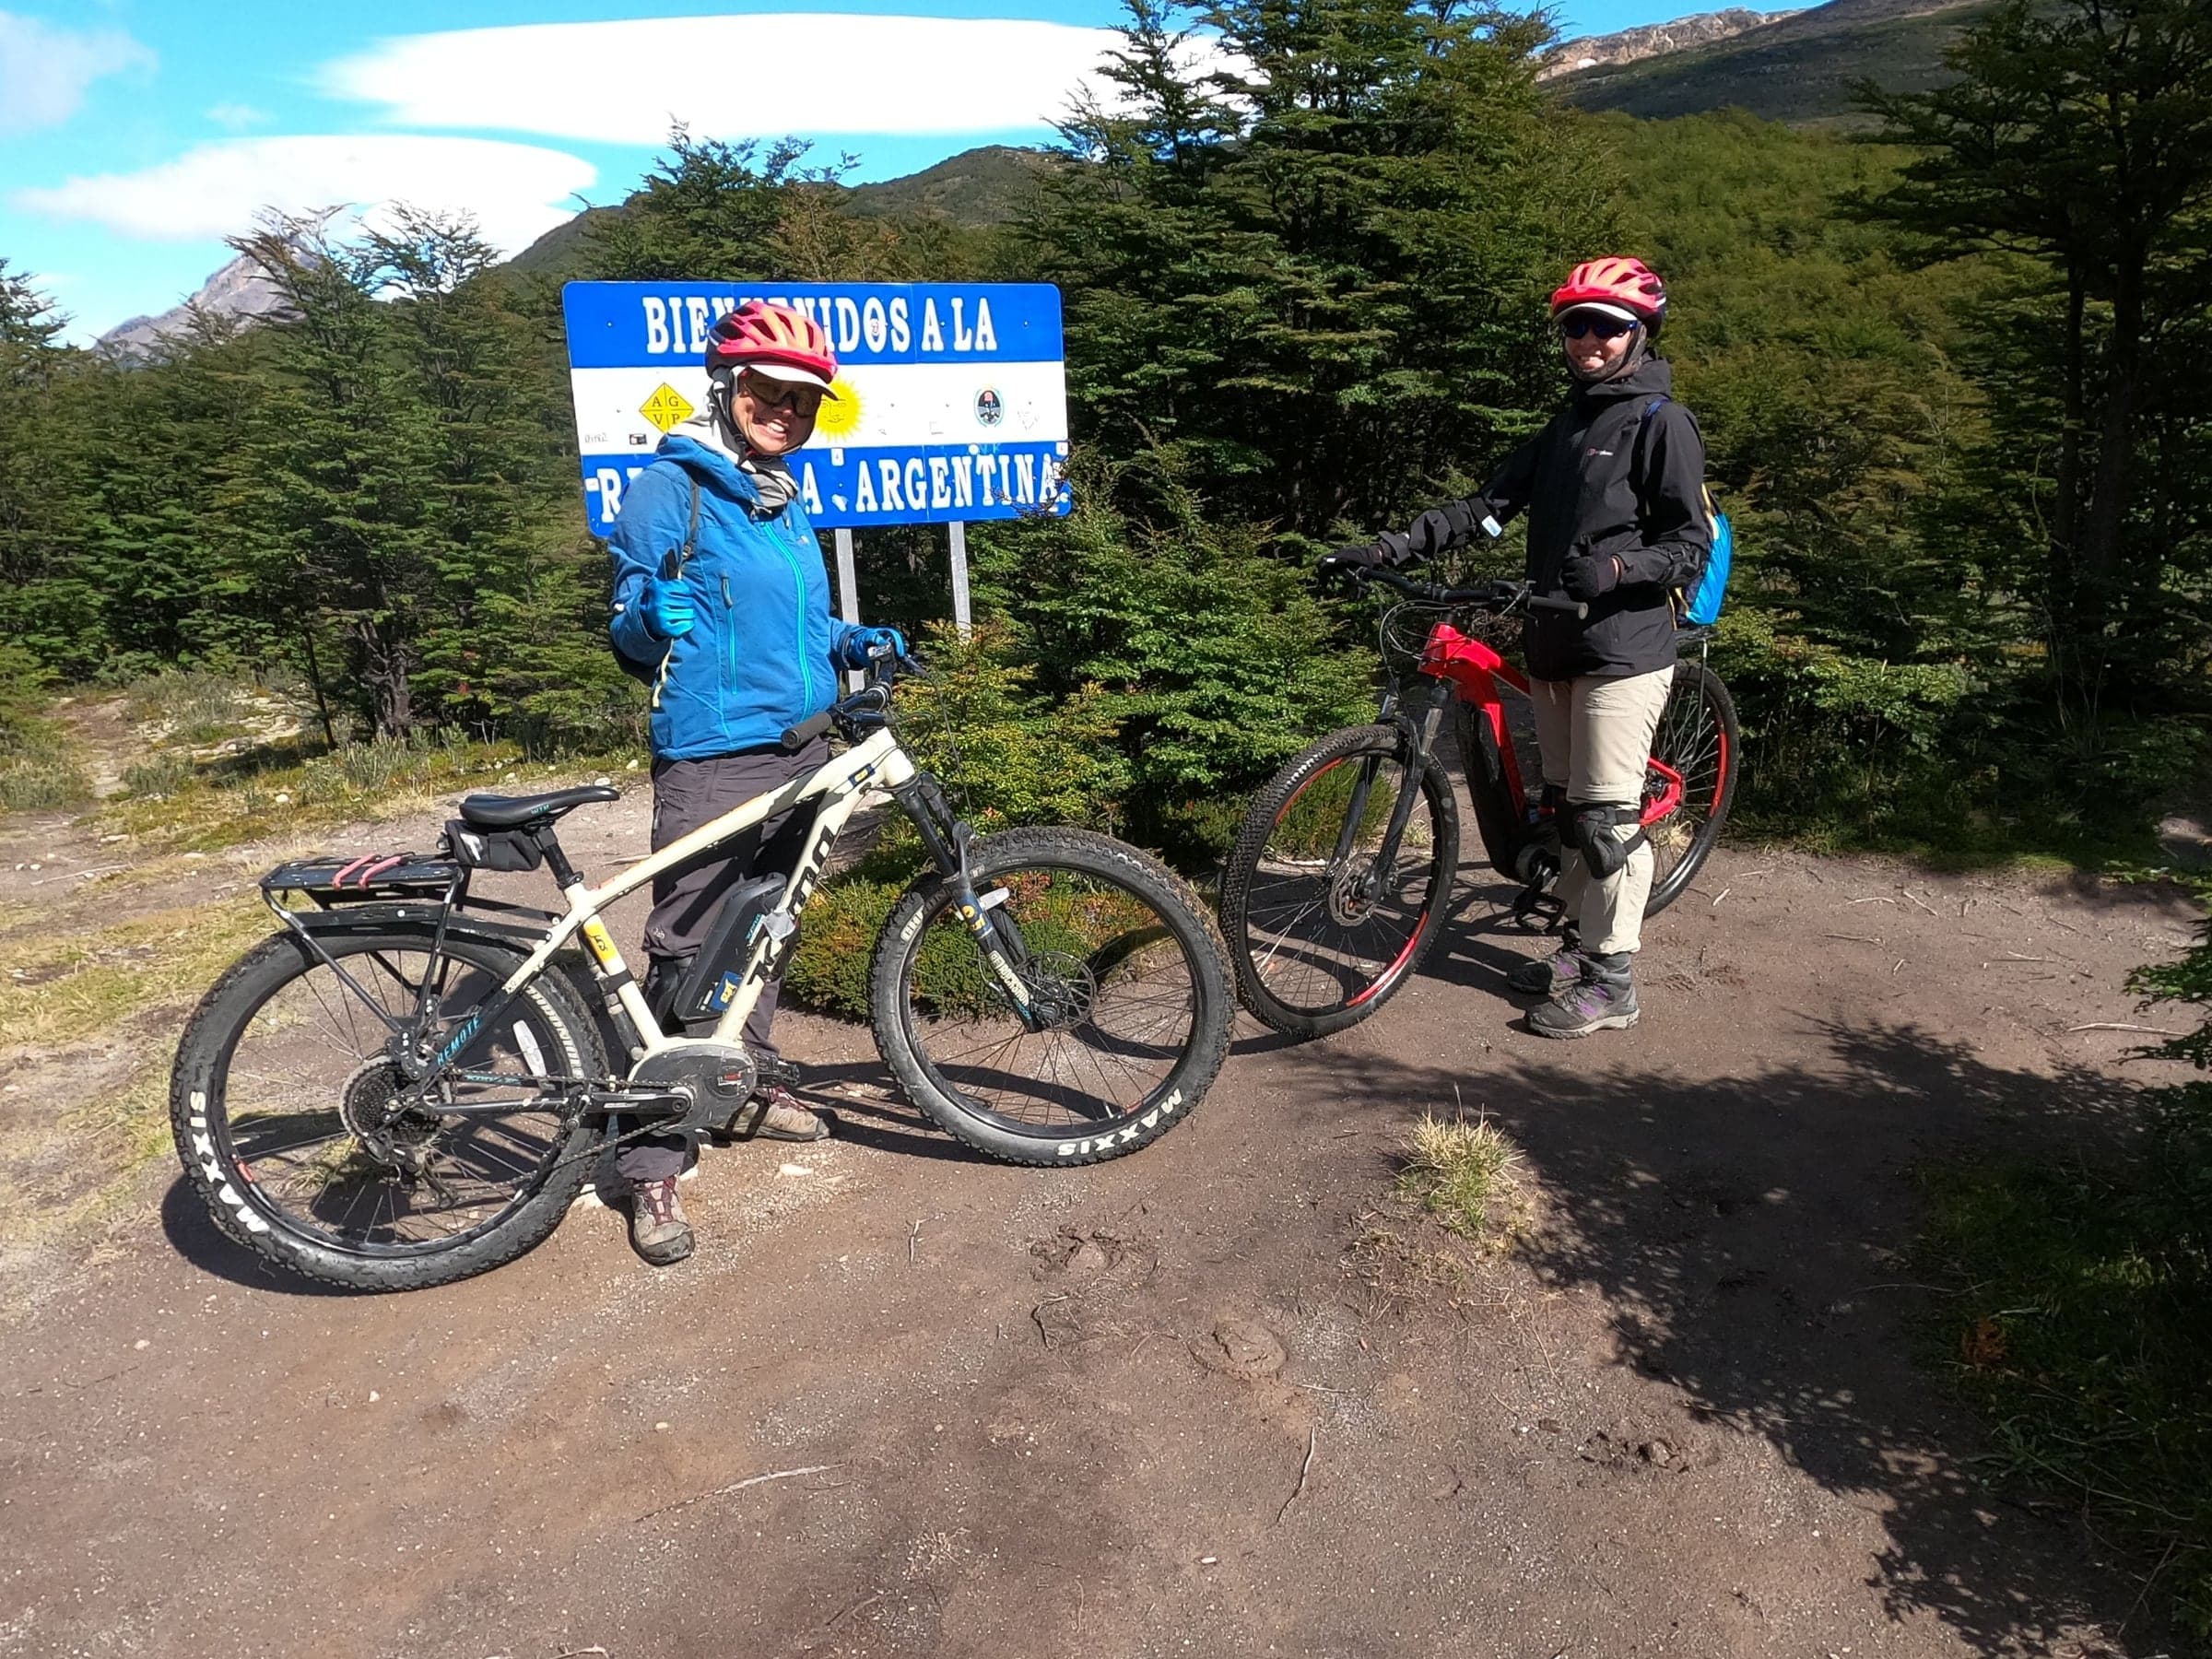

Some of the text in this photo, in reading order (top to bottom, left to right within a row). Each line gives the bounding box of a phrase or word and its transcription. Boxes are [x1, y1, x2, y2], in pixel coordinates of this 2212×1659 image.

[641, 296, 997, 354] BIEIDOS A LA
[855, 453, 1058, 512] ARGENTINA
[437, 1016, 483, 1066] REMOTE
[1057, 1088, 1182, 1157] MAXXIS
[190, 1090, 270, 1232] MAXXIS
